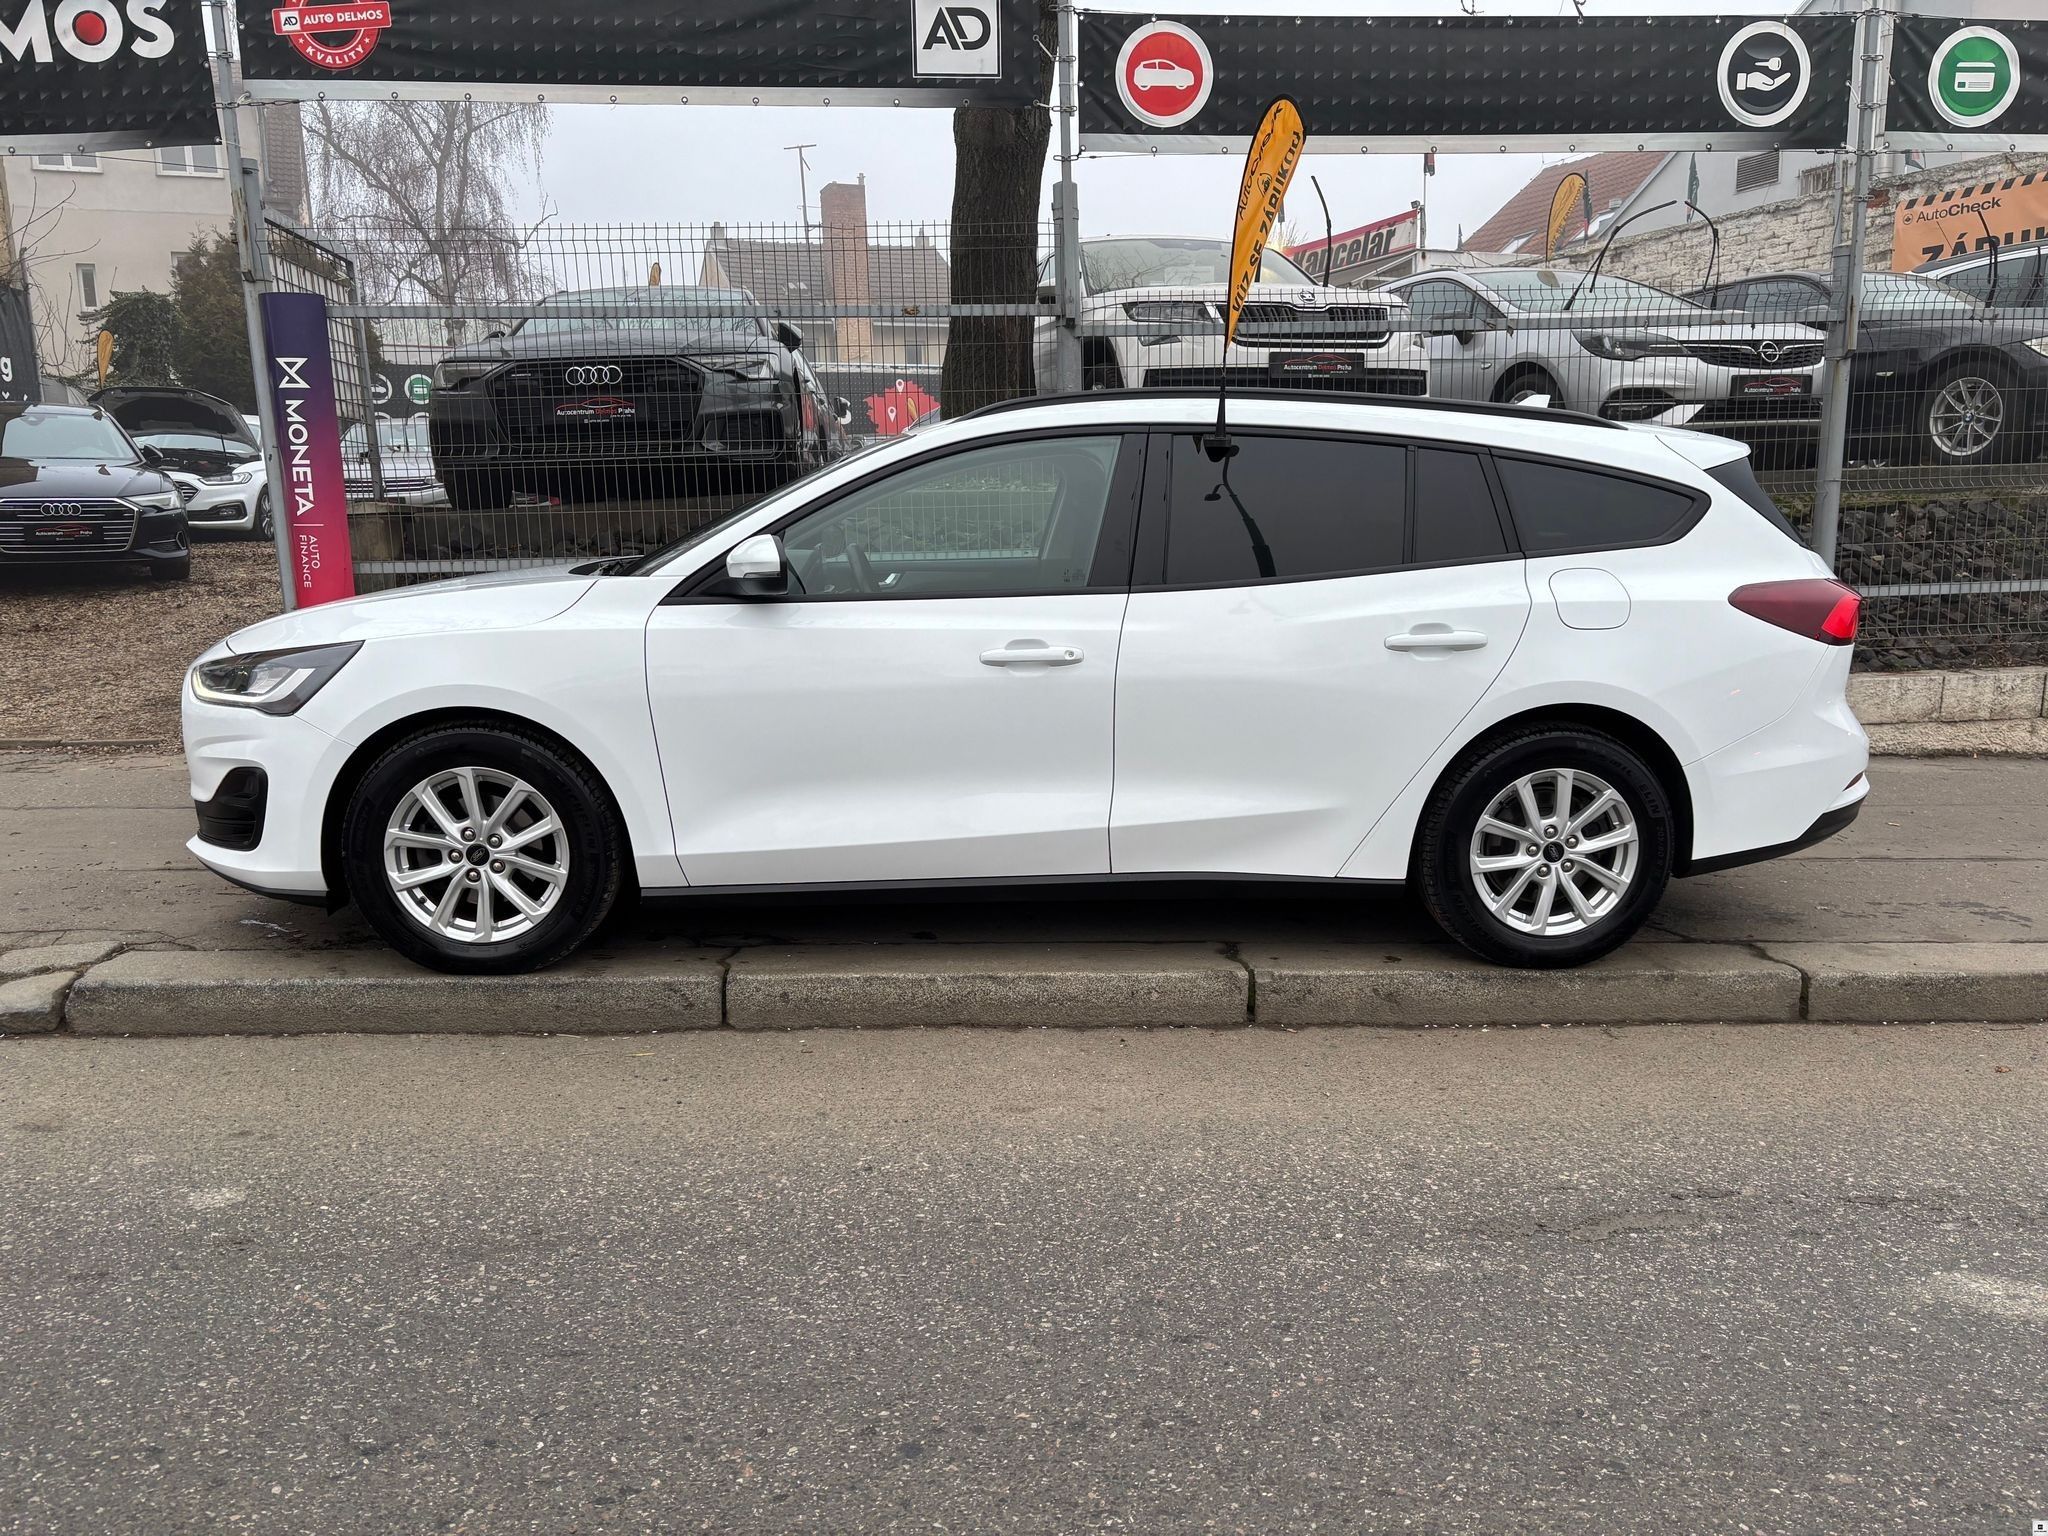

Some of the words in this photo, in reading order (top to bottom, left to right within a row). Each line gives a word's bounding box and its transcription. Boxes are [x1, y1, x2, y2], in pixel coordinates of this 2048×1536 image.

[0, 0, 175, 63] MOS
[303, 13, 334, 25] AUTO
[336, 10, 383, 22] DELMOS
[922, 7, 991, 50] AD
[305, 44, 365, 64] KVALITY
[1916, 196, 2002, 223] AutoCheck
[1249, 239, 1262, 267] SE
[556, 408, 595, 416] Autocentrum
[285, 399, 315, 517] MONETA
[299, 534, 312, 588] FINANCE
[309, 534, 321, 570] AUTO
